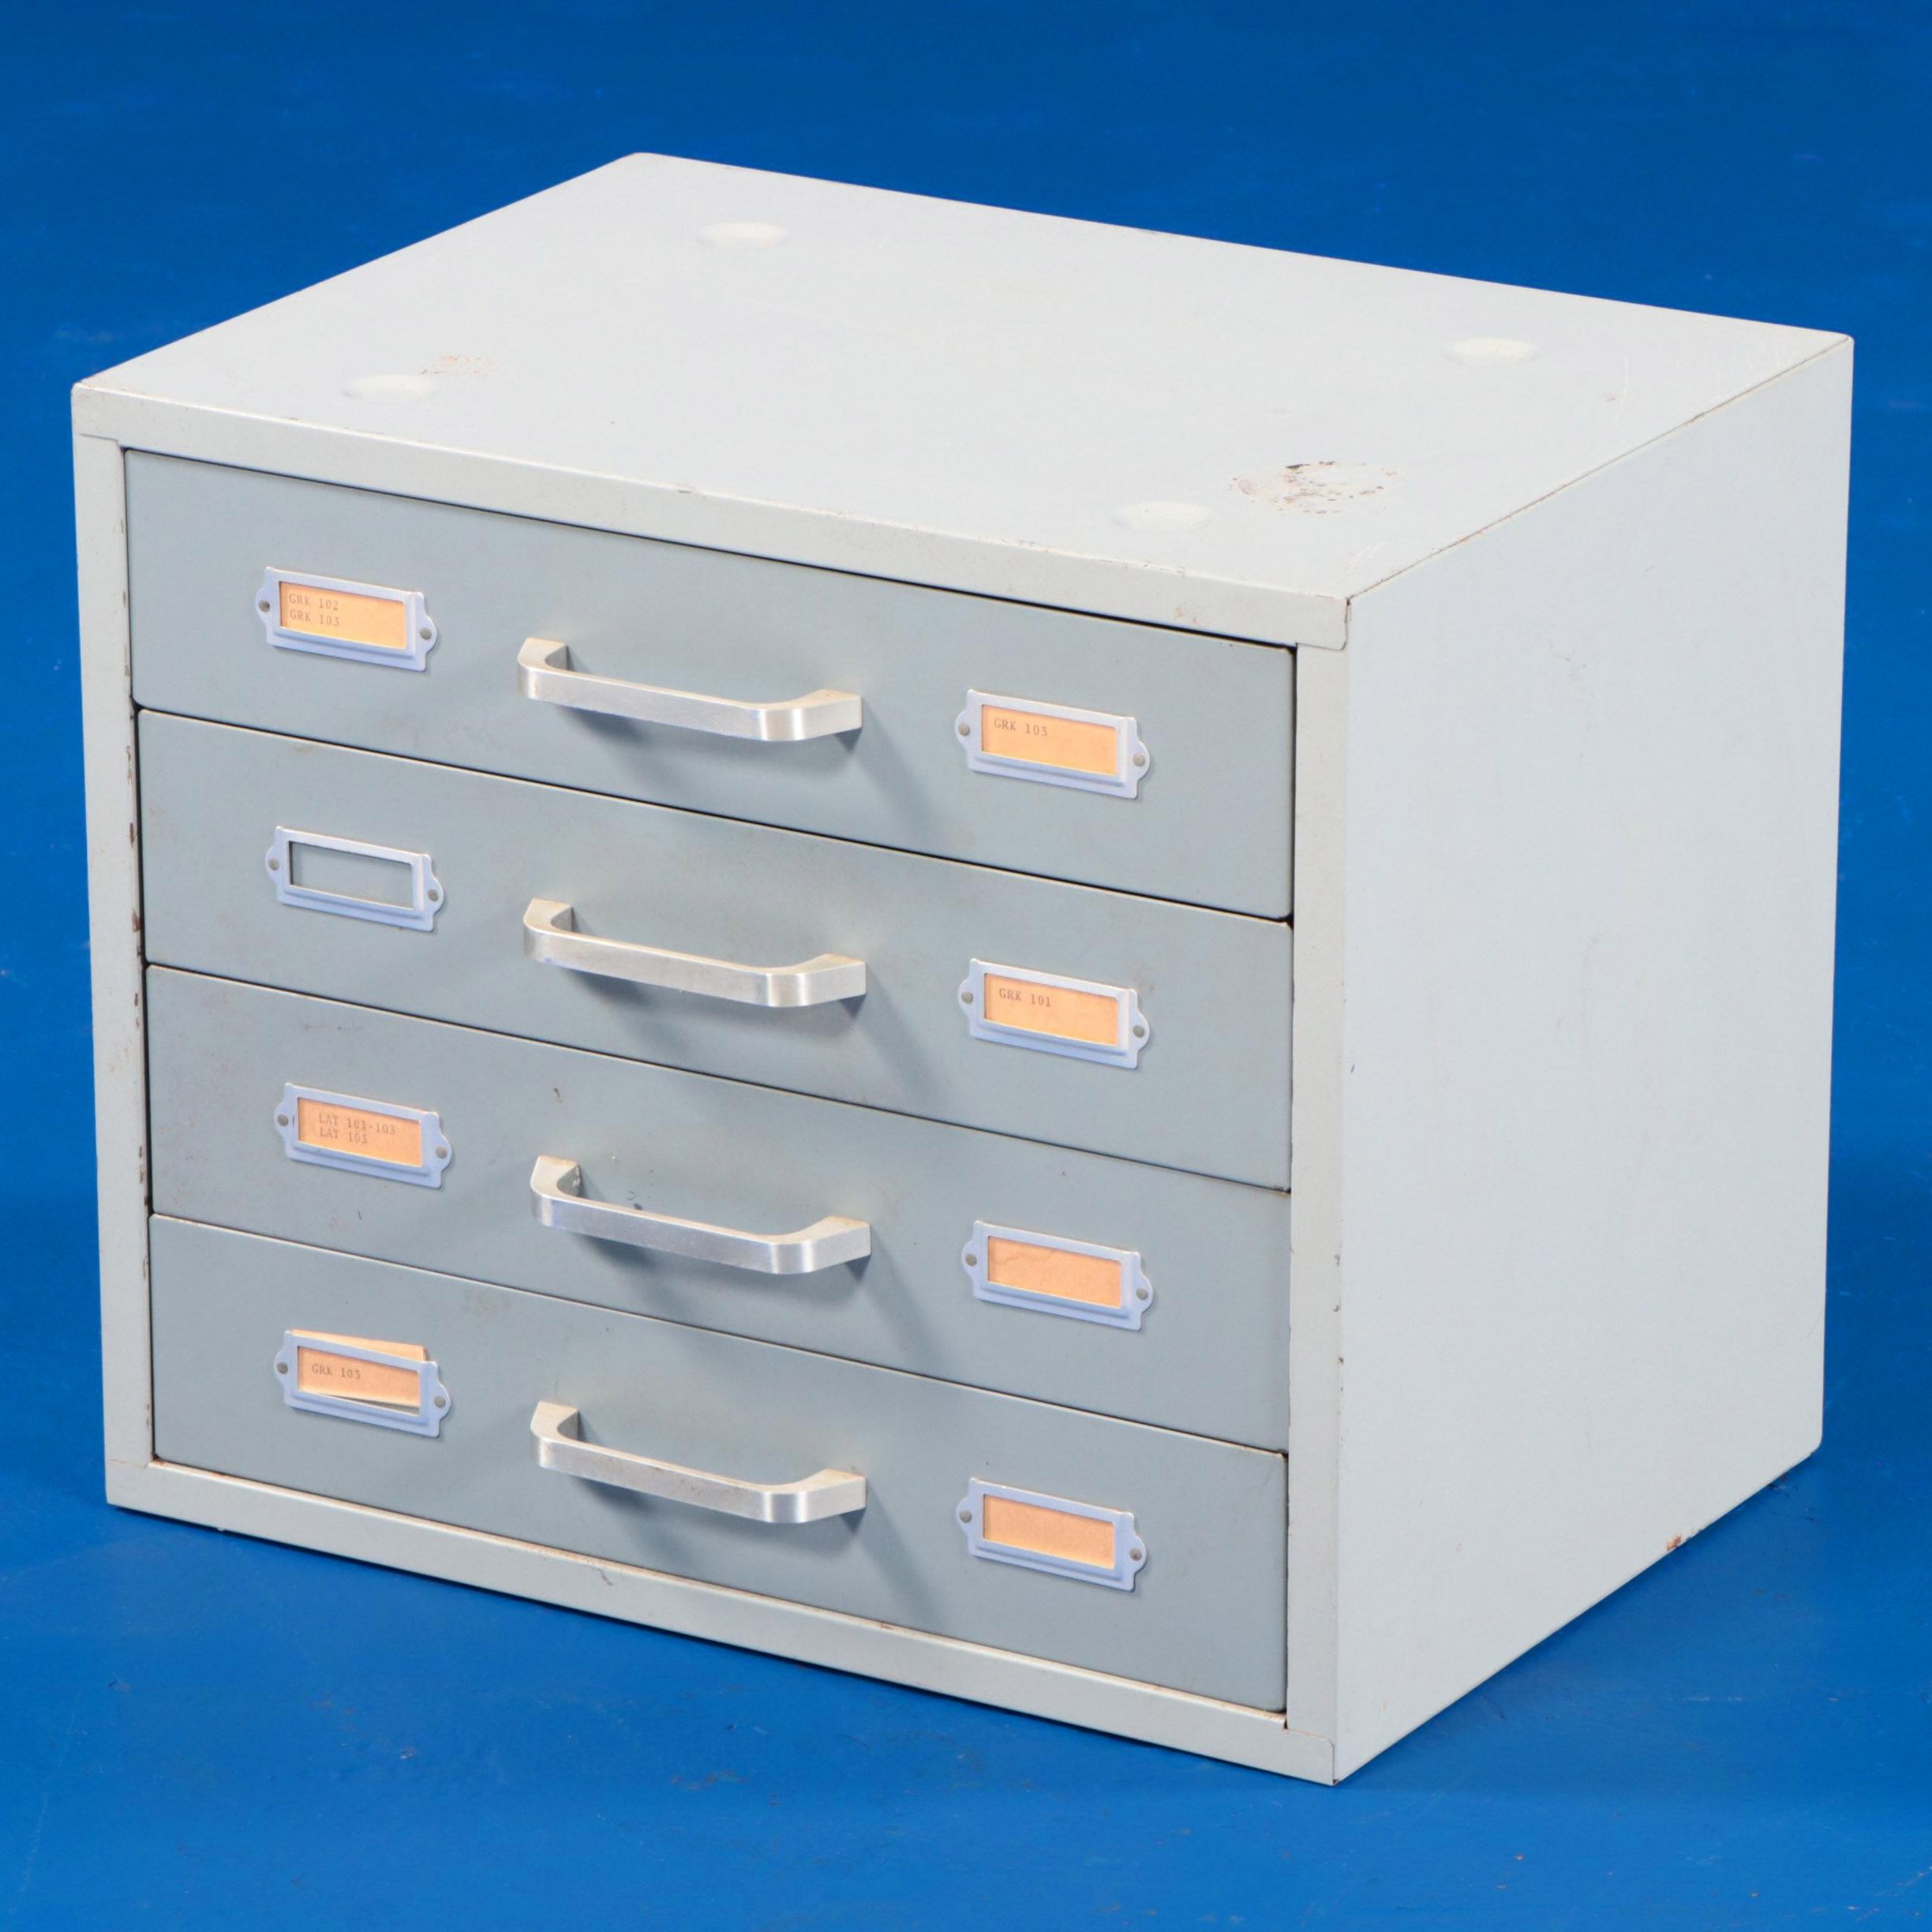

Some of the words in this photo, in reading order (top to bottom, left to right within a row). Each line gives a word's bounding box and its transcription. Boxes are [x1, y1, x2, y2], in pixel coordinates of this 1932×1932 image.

[289, 593, 310, 606] GRK
[319, 598, 339, 611] 102
[290, 608, 311, 623] GRK
[320, 614, 340, 627] 103
[994, 717, 1017, 731] GRK
[1025, 723, 1048, 737] 103
[999, 987, 1022, 1002] GRK
[1031, 993, 1050, 1008] 101
[318, 1112, 339, 1125] LAT
[347, 1118, 396, 1135] 101-103
[320, 1126, 339, 1139] LAT
[348, 1132, 368, 1144] 103
[312, 1363, 332, 1376] GRK
[341, 1367, 361, 1380] 103
